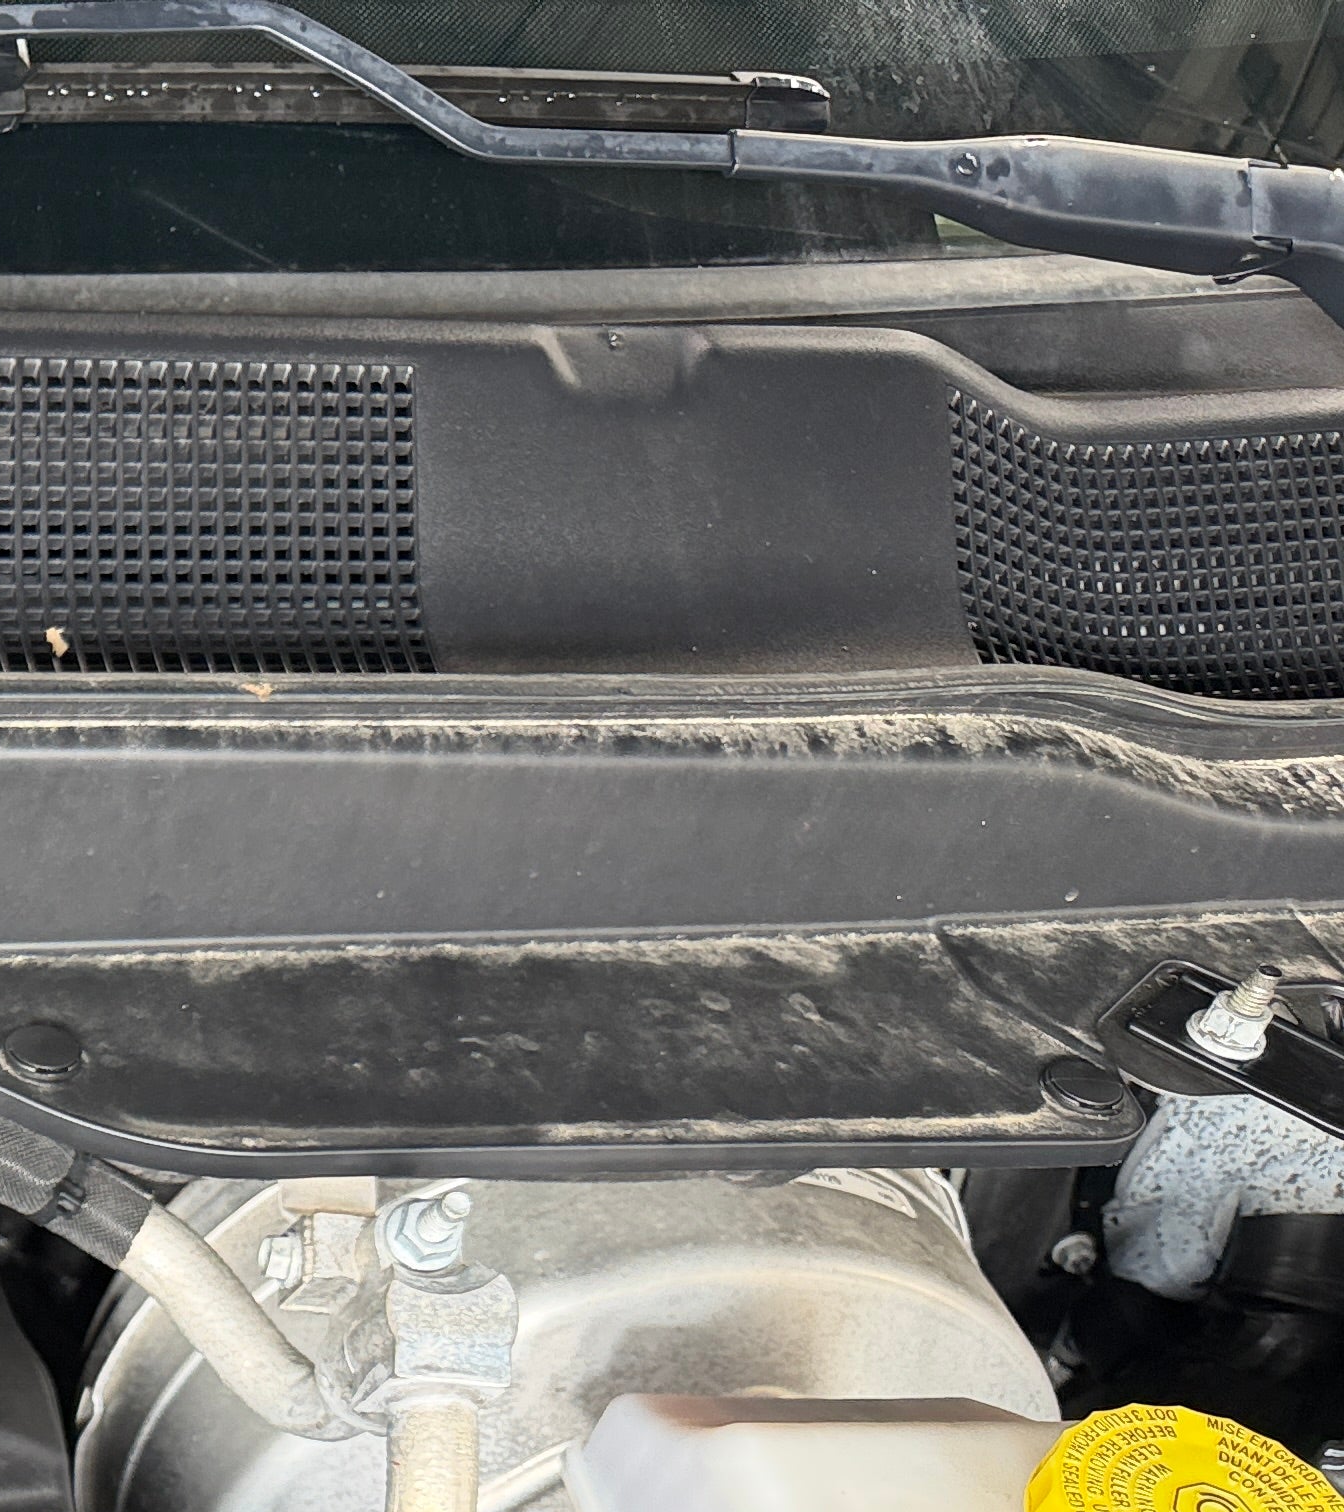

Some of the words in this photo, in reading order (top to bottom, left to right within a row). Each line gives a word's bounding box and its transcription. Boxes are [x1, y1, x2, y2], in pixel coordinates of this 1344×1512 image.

[1146, 1408, 1178, 1422] DOT
[1115, 1425, 1178, 1446] BEFORE
[1207, 1417, 1246, 1440] MISE
[1249, 1434, 1274, 1452] EN
[1119, 1443, 1163, 1470] CLEAN
[1217, 1436, 1275, 1468] AVANT
[1272, 1465, 1298, 1486] DE
[1291, 1484, 1318, 1503] LE
[1062, 1463, 1085, 1508] SEALED
[1218, 1450, 1243, 1469] DU
[1245, 1463, 1304, 1512] LIQUIDE
